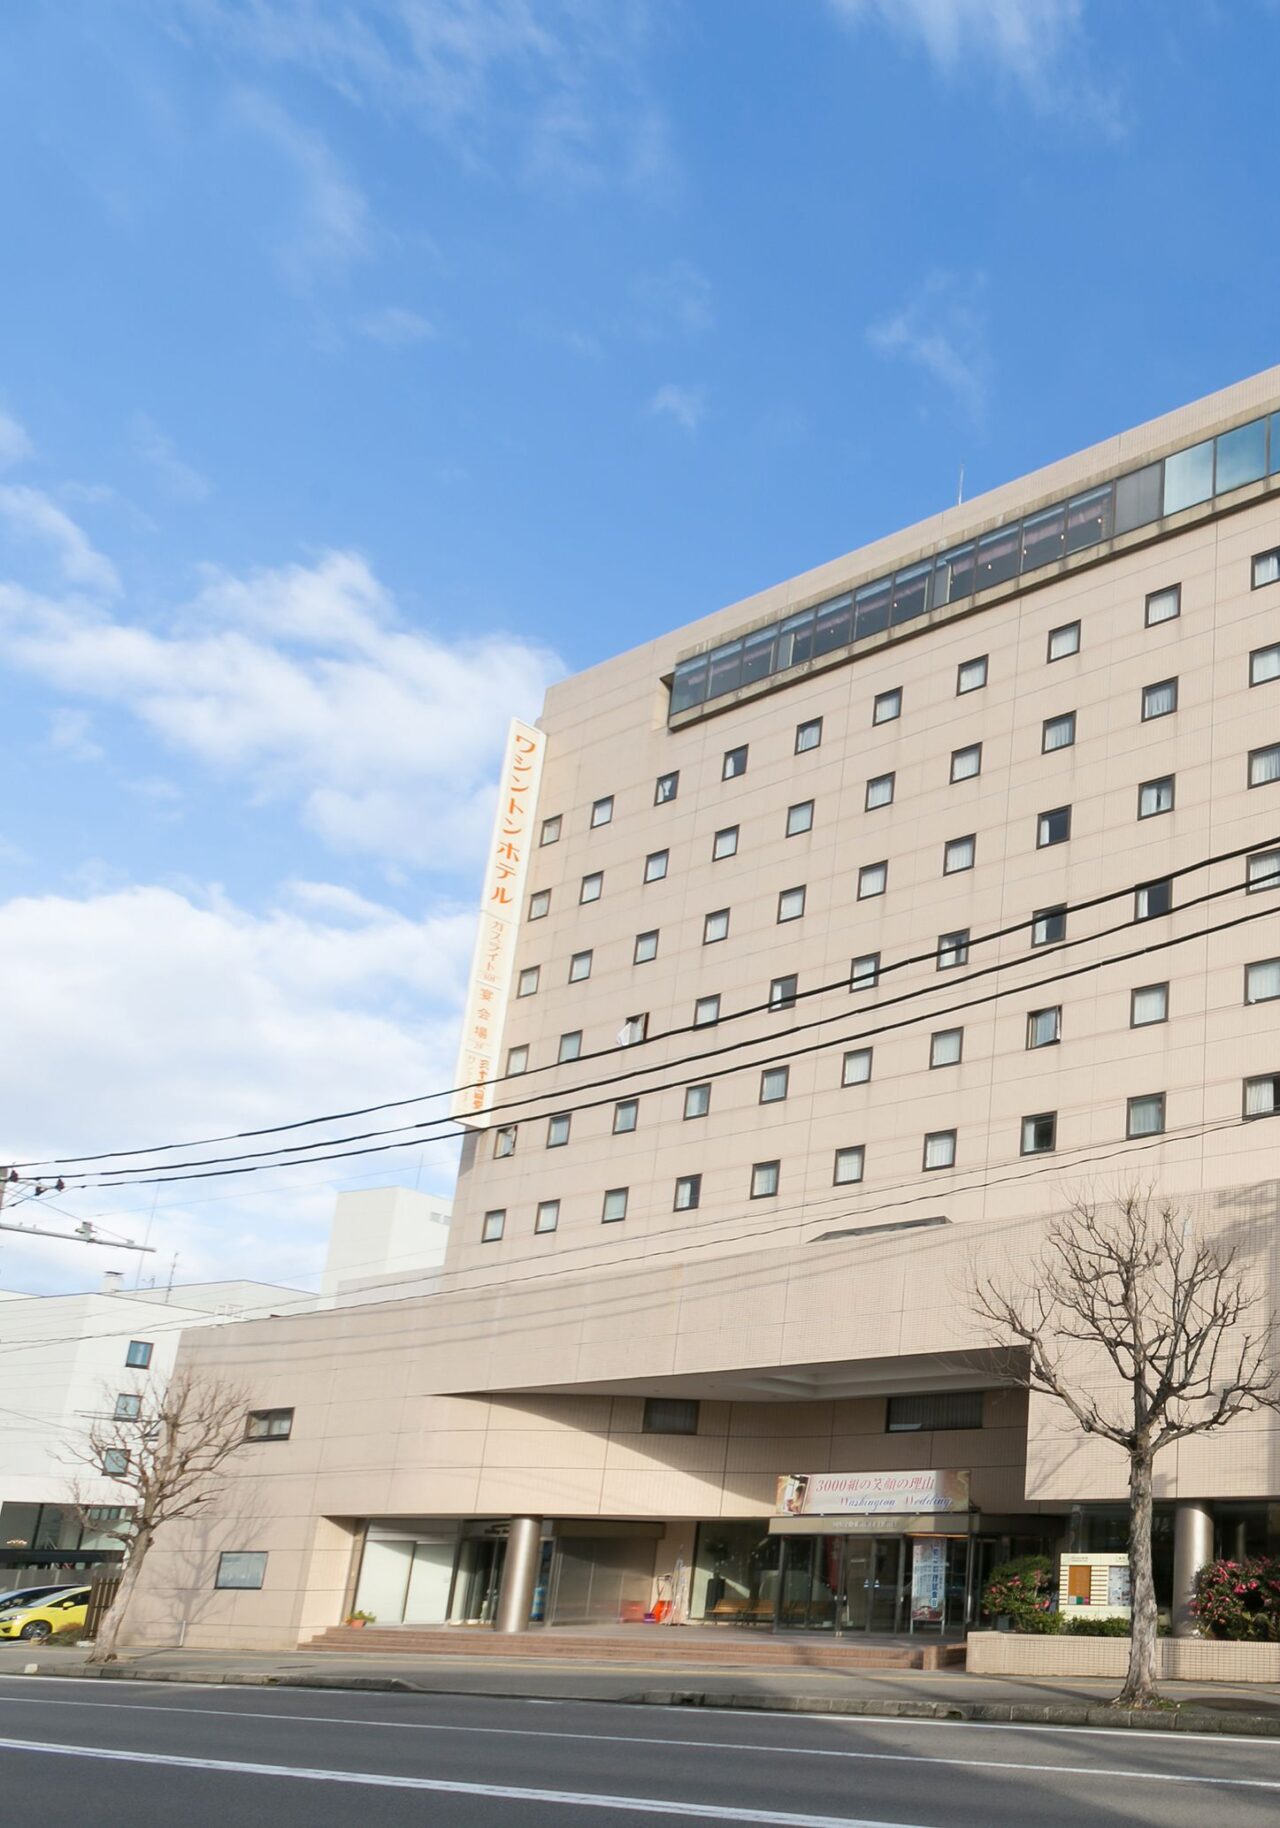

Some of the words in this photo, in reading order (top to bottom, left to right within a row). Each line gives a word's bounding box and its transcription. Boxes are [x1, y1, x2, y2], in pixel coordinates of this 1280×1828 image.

[491, 734, 536, 904] ワシントンホテル
[473, 988, 494, 1040] 宴会場
[840, 1494, 896, 1511] Washington
[905, 1493, 952, 1509] Wedding
